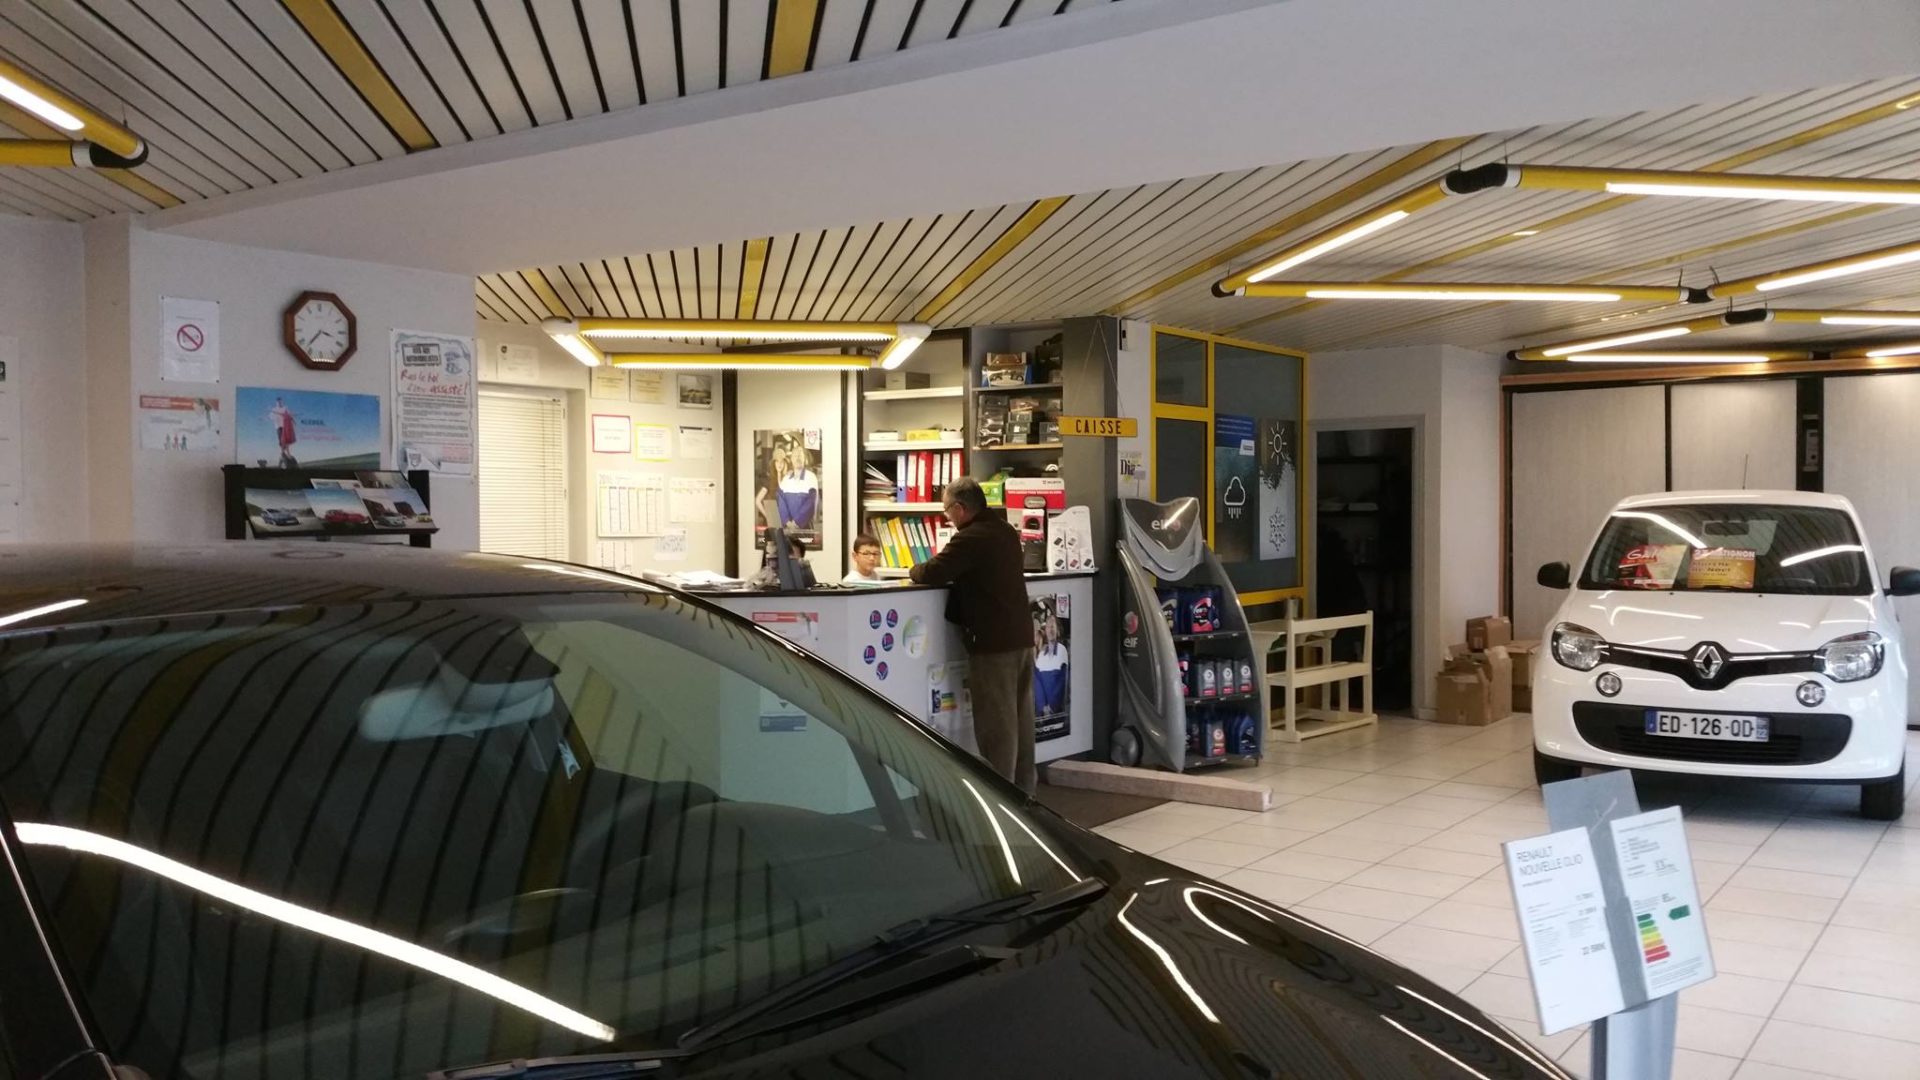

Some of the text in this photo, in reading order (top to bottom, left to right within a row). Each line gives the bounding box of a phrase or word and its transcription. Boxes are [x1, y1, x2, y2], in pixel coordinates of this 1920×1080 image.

[1075, 419, 1122, 434] CAISSE
[1123, 637, 1138, 648] elf
[1516, 845, 1553, 862] RENAULT
[1519, 858, 1562, 876] NOUVELLE
